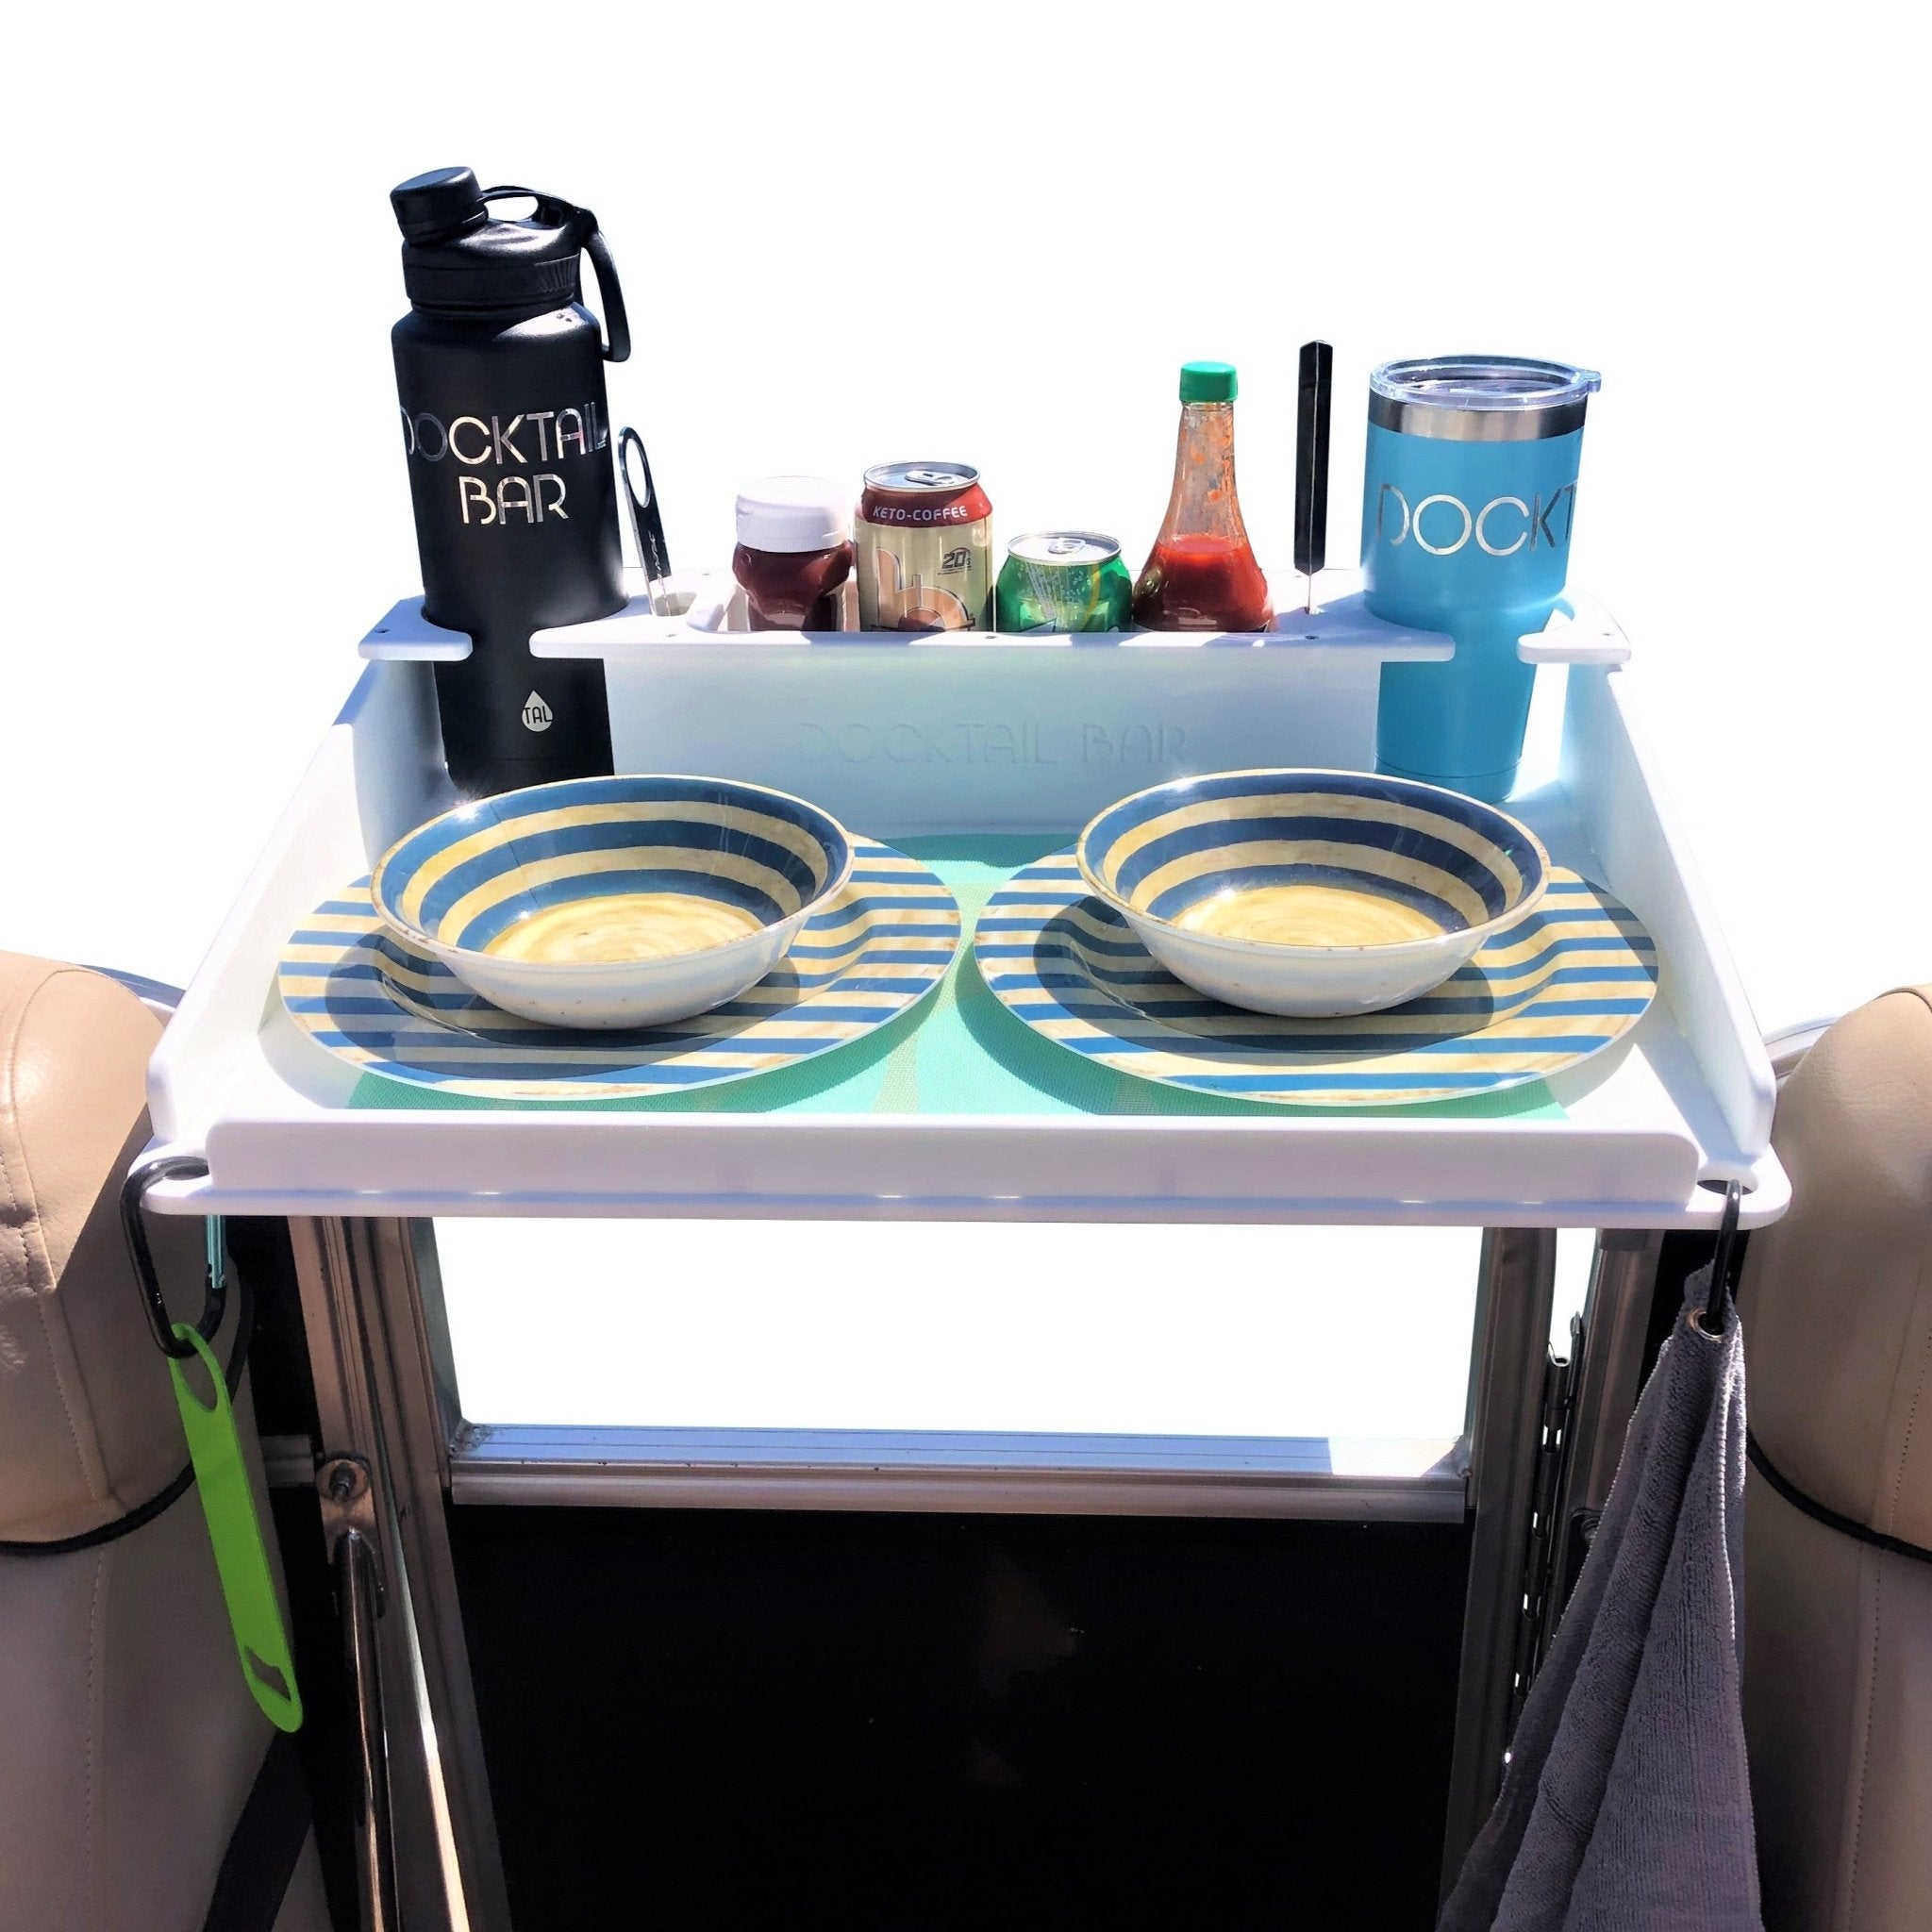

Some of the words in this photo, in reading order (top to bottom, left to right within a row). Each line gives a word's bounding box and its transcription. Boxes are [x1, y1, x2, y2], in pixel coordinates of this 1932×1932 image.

[458, 473, 570, 525] BAR
[872, 505, 969, 521] KETO-COFFEE
[522, 706, 554, 724] TAL
[798, 723, 1059, 764] DOCKTAIL
[1082, 722, 1188, 764] BAR
